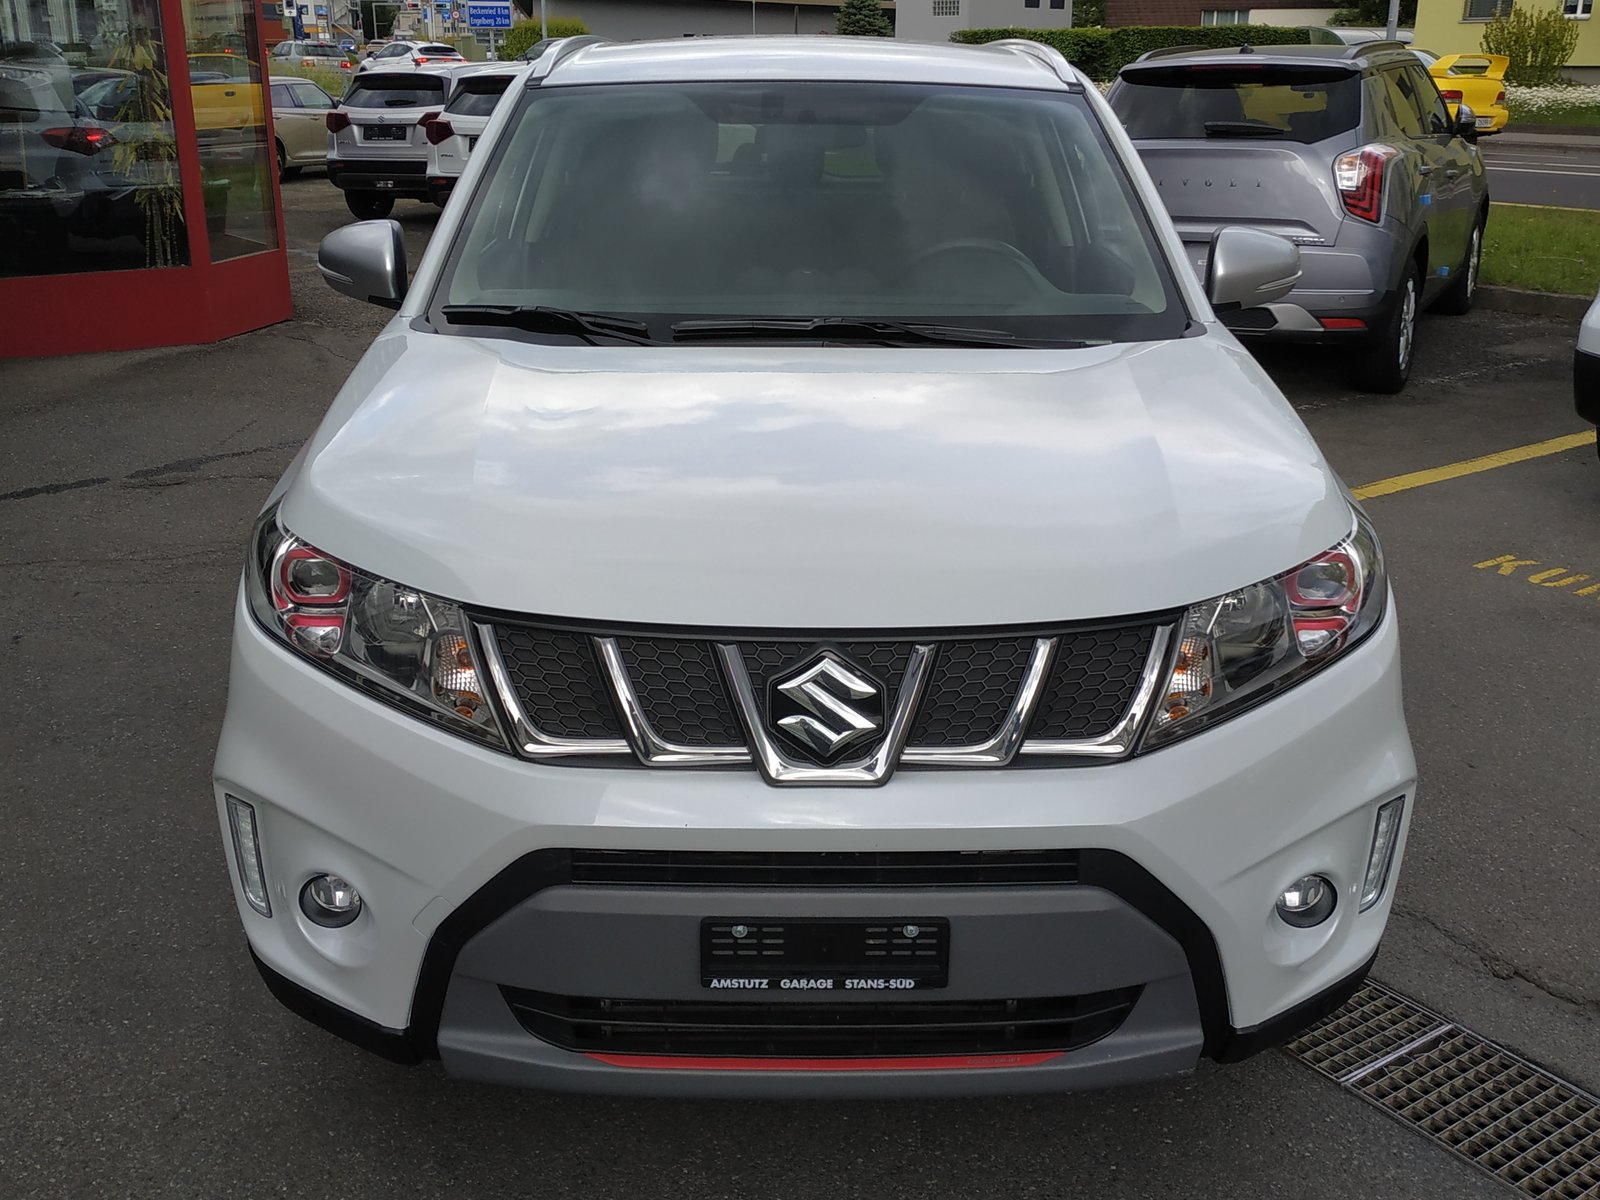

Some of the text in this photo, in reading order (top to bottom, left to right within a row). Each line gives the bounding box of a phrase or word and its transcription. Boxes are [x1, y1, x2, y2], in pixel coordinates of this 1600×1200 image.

[470, 7, 496, 15] Beckenried
[501, 7, 509, 15] km
[471, 17, 510, 26] Engelberg 20 km
[1158, 178, 1263, 188] IVOLI
[710, 978, 915, 989] AMSTUTZ GARAGE STANS-SÜD
